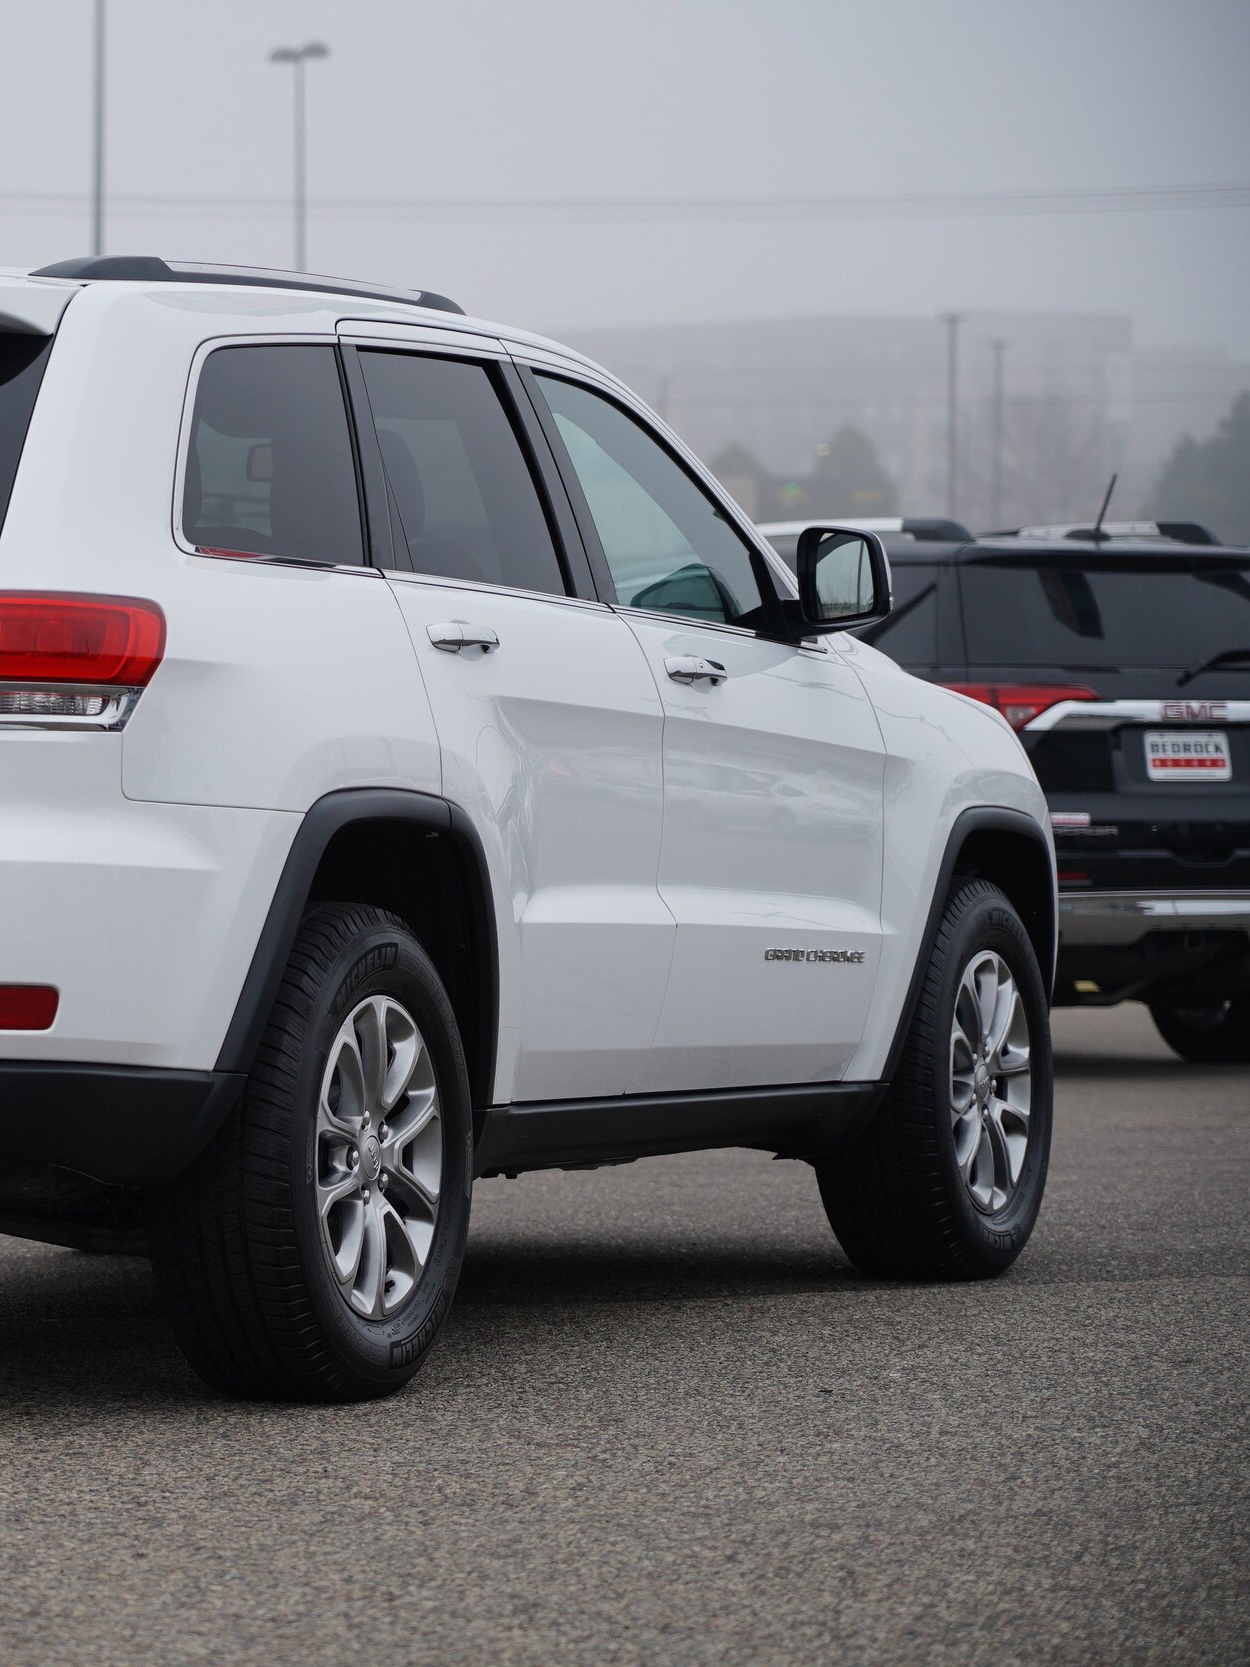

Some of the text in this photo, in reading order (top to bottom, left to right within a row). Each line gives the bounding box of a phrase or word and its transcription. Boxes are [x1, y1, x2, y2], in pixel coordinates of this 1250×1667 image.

[1162, 701, 1229, 721] GMC
[1150, 741, 1224, 755] BEDROCK
[764, 947, 867, 964] GRAND CHEROKEE
[335, 945, 397, 1013] MICHELIN
[391, 1292, 449, 1368] MICHELIN
